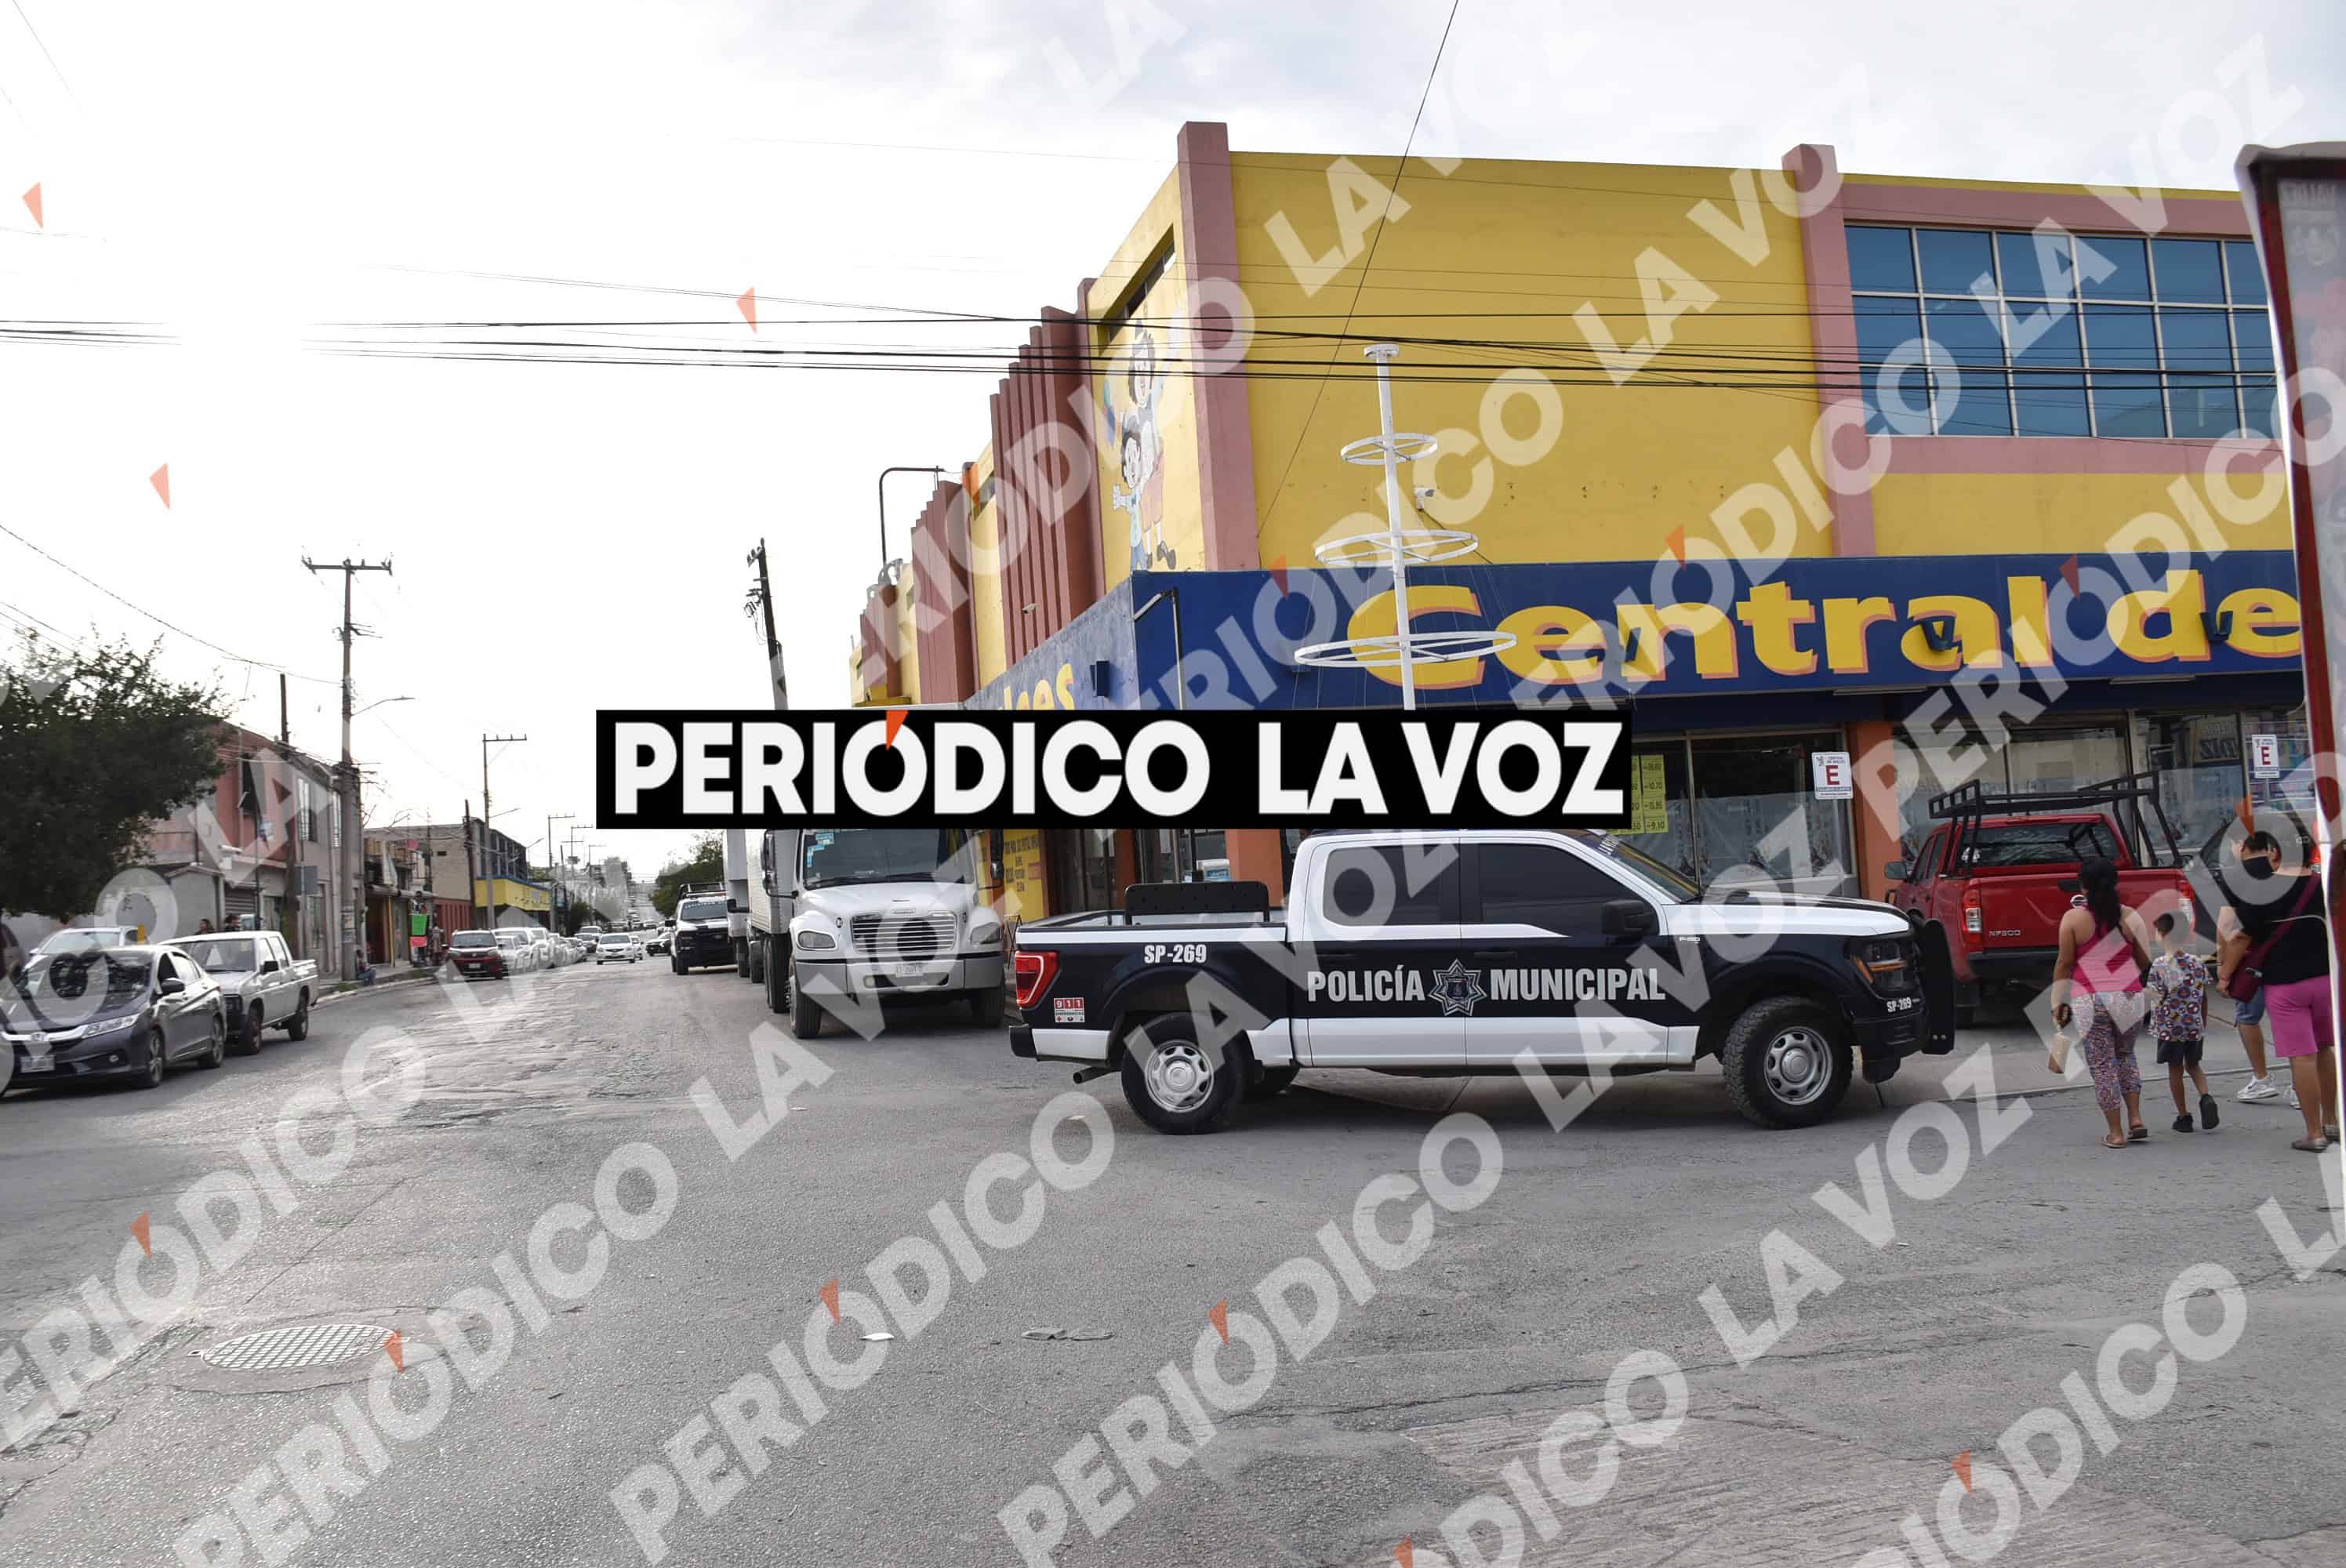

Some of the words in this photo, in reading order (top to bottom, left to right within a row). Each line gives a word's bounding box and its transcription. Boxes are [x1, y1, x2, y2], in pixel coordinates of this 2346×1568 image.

[1348, 576, 2054, 690] Central
[2106, 569, 2303, 663] de
[2261, 746, 2272, 765] E
[1825, 764, 1840, 786] E
[1144, 943, 1207, 963] SP-269
[1307, 965, 1425, 1002] POLICÍA
[1491, 967, 1665, 1001] MUNICIPAL
[1887, 997, 1912, 1012] SP-269
